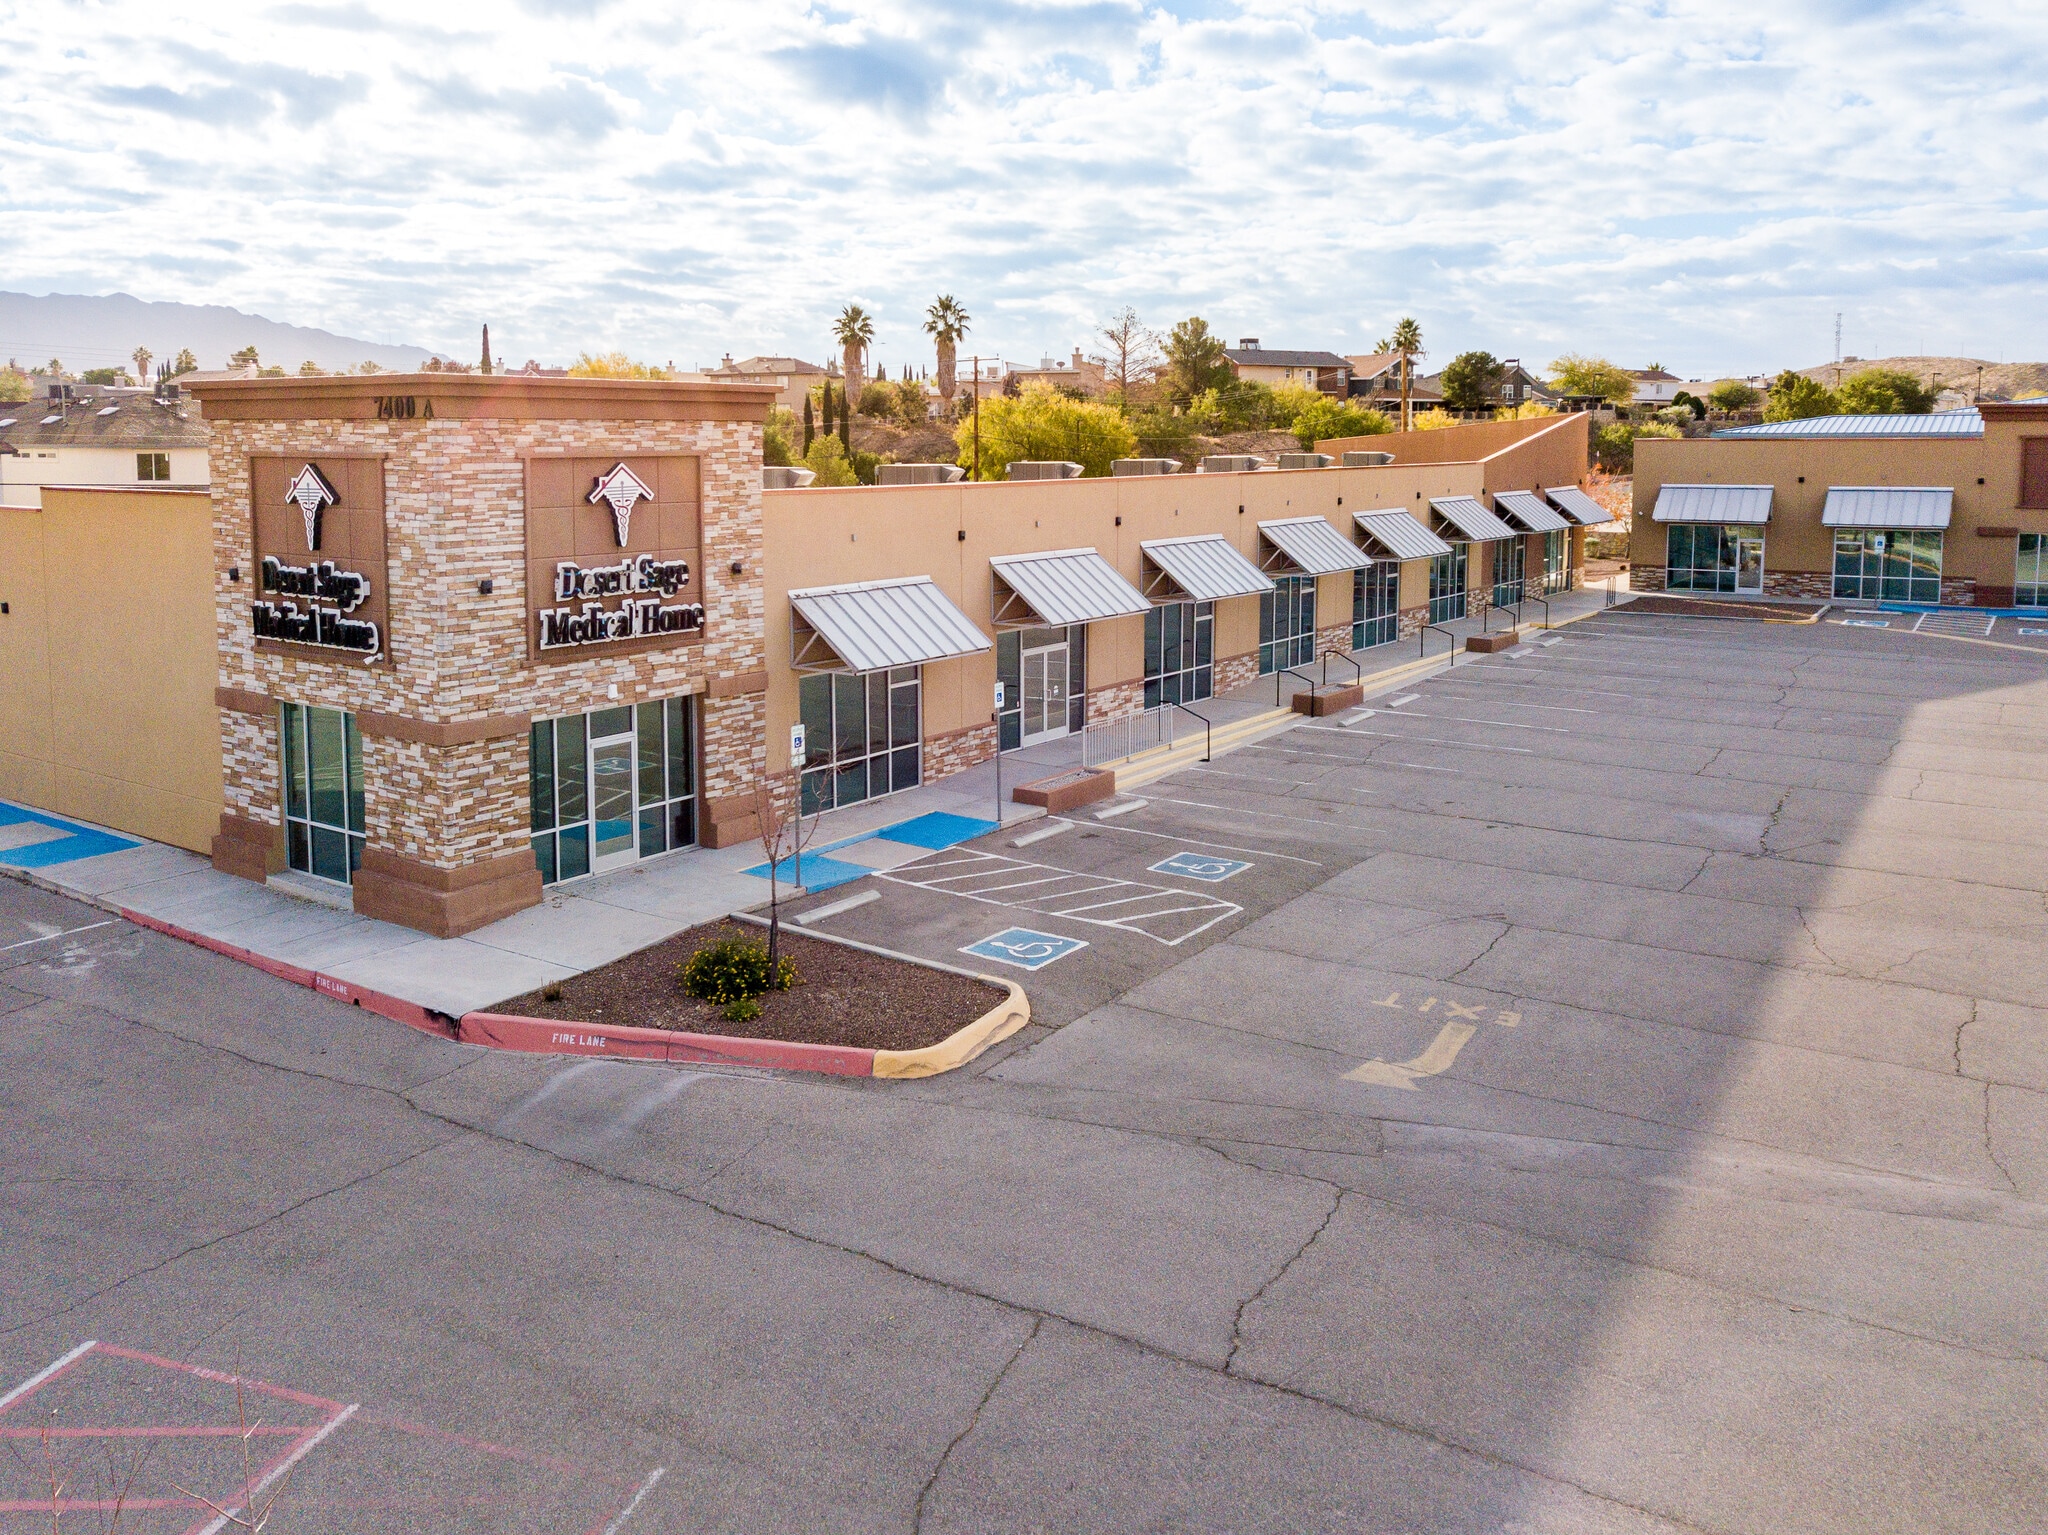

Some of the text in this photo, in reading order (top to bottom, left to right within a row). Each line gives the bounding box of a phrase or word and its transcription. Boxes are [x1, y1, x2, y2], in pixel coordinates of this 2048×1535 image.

[373, 396, 434, 419] 7400 A
[558, 556, 690, 600] Desert Sage
[543, 601, 705, 647] Medical Home
[316, 976, 348, 996] FIRE LANE
[1370, 991, 1523, 1028] EXIT
[552, 1033, 606, 1047] FIRE LANE
